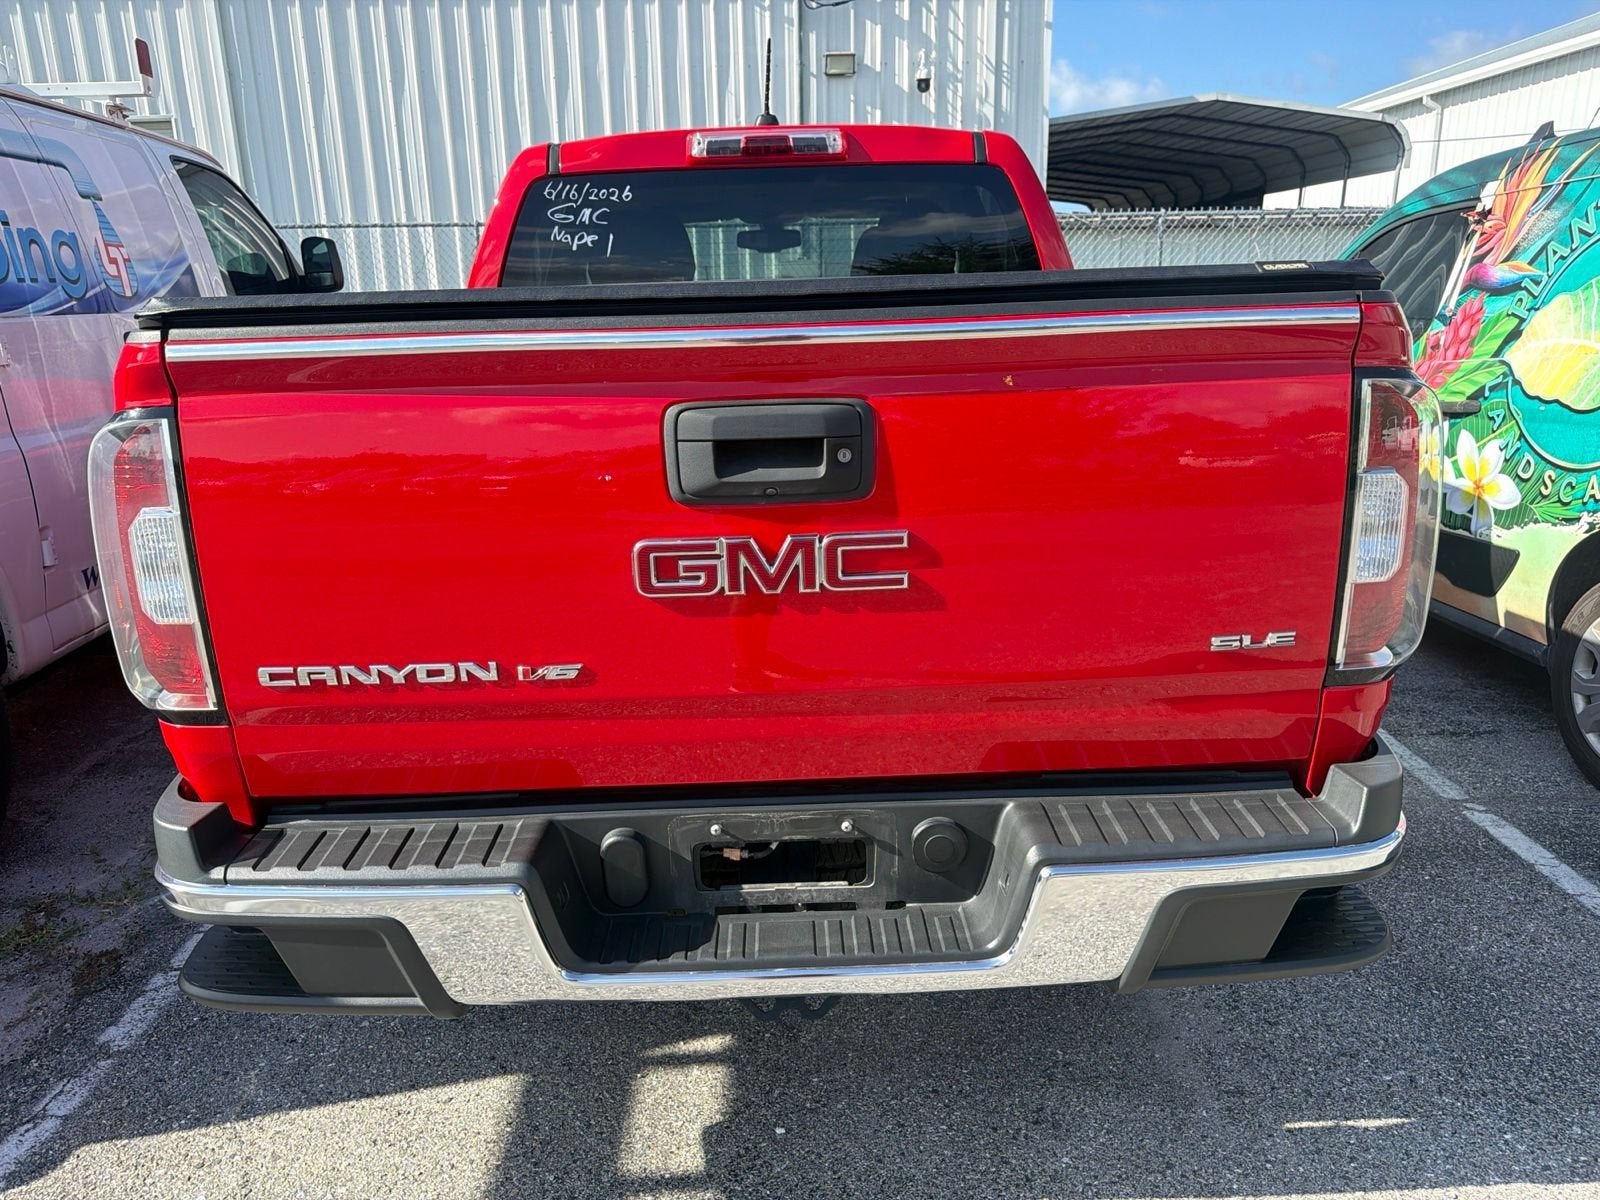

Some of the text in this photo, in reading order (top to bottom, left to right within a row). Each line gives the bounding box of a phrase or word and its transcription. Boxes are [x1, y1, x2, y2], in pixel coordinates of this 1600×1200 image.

[543, 181, 633, 206] 6/16/2026
[547, 203, 610, 225] GMC
[0, 209, 88, 300] ing
[1508, 199, 1600, 320] PLAN
[632, 530, 909, 597] GMC
[1210, 630, 1297, 652] SLE
[257, 661, 584, 687] CANYON V6
